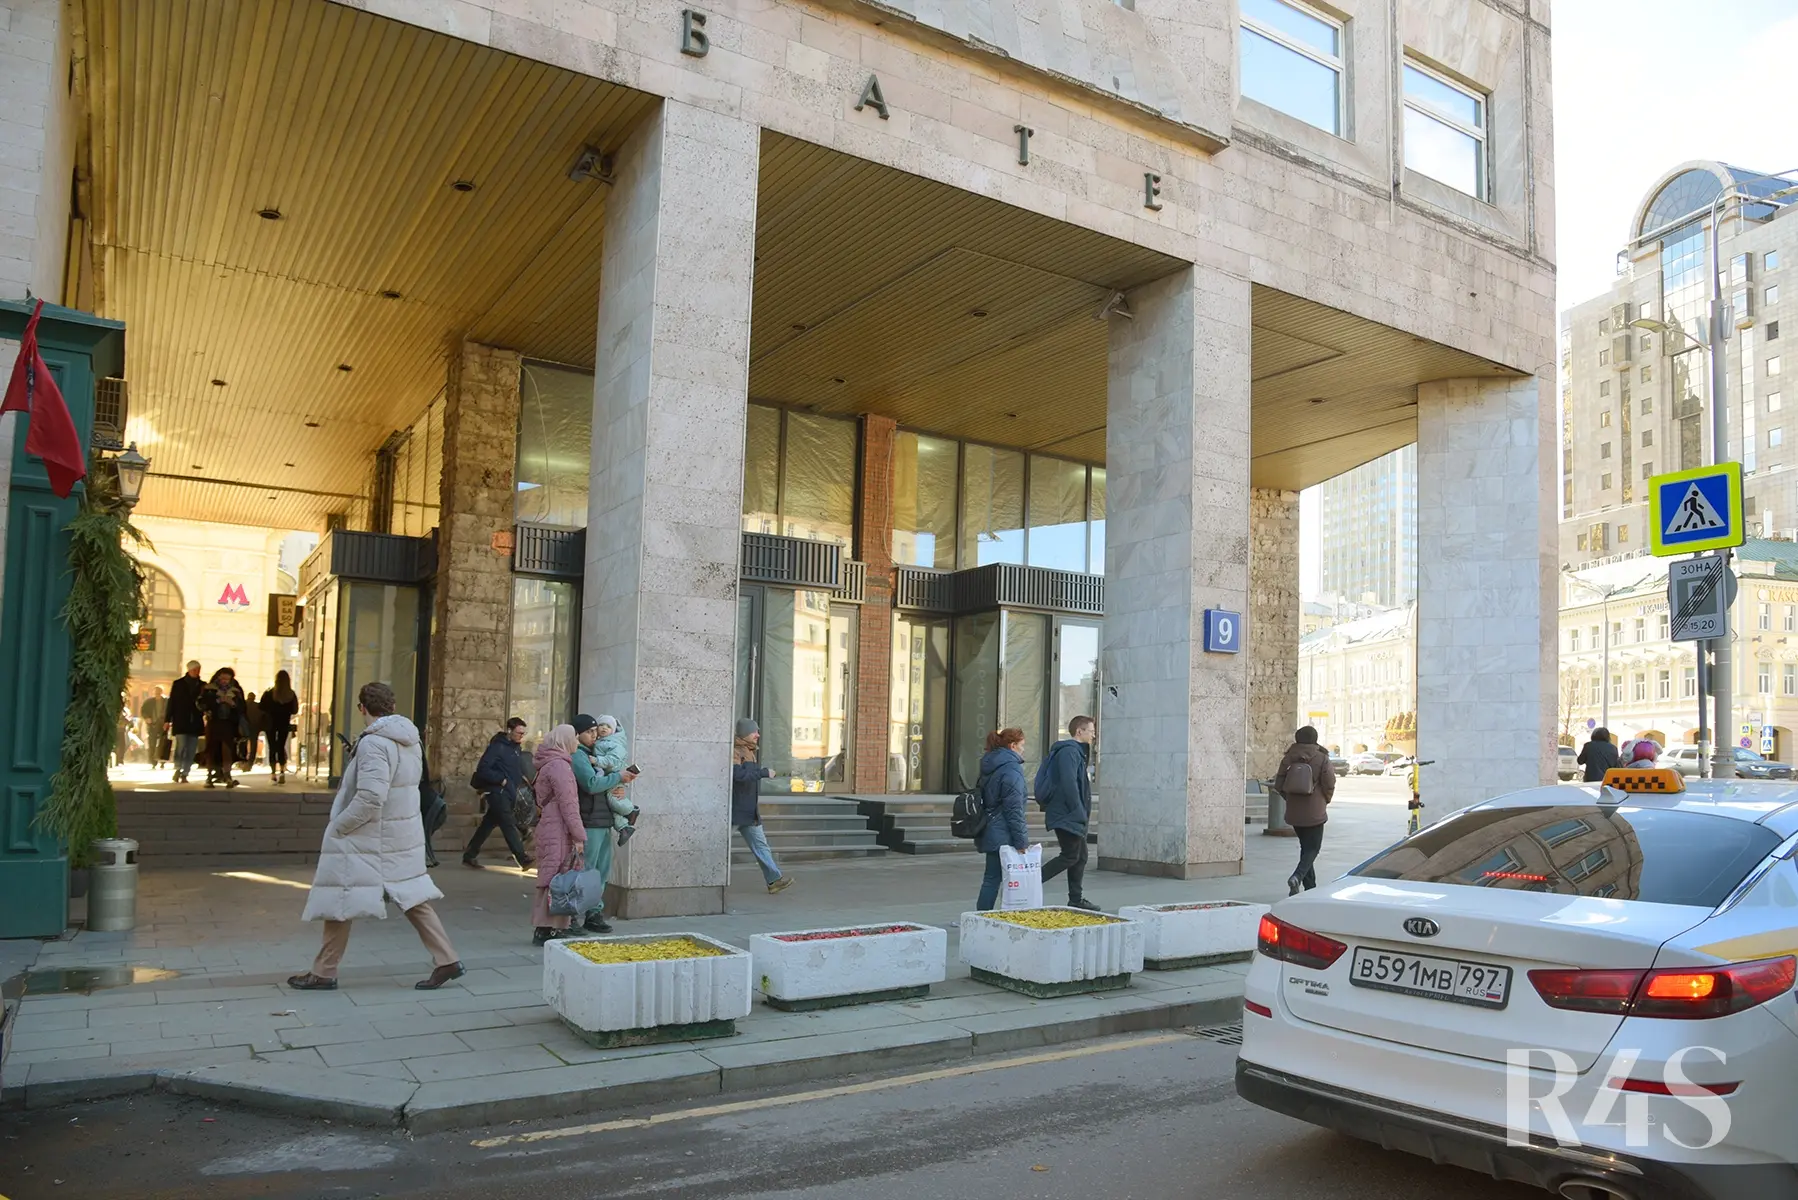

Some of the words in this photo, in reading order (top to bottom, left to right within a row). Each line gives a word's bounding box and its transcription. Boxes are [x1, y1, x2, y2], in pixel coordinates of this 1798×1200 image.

[1681, 562, 1711, 575] ЗОНА
[218, 582, 250, 606] М
[1219, 618, 1233, 645] 9
[1690, 621, 1699, 630] 15
[1701, 620, 1715, 630] 20
[1407, 919, 1434, 934] KIA
[1360, 955, 1453, 990] В591МВ
[1460, 965, 1500, 990] 797
[1466, 987, 1486, 997] RUS
